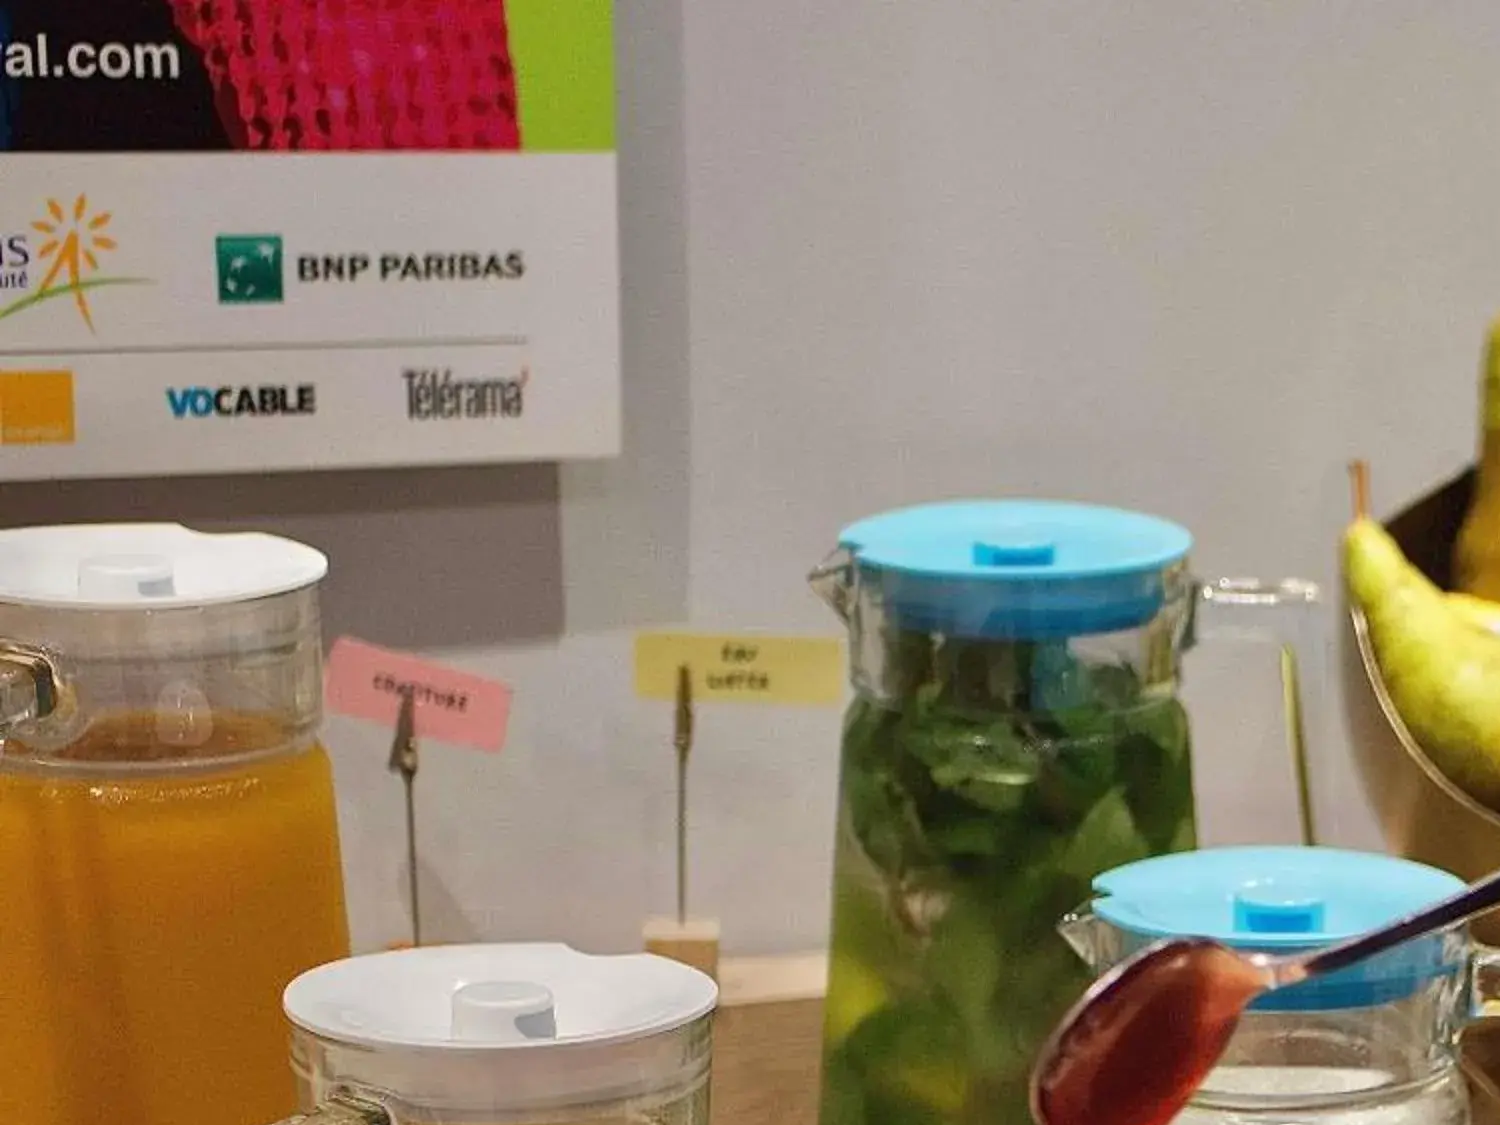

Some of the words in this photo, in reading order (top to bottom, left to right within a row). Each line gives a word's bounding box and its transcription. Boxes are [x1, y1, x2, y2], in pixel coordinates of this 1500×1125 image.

[0, 32, 181, 79] al.com
[298, 253, 370, 281] BNP
[379, 250, 525, 280] PARIBAS
[166, 384, 317, 418] VOCABLE
